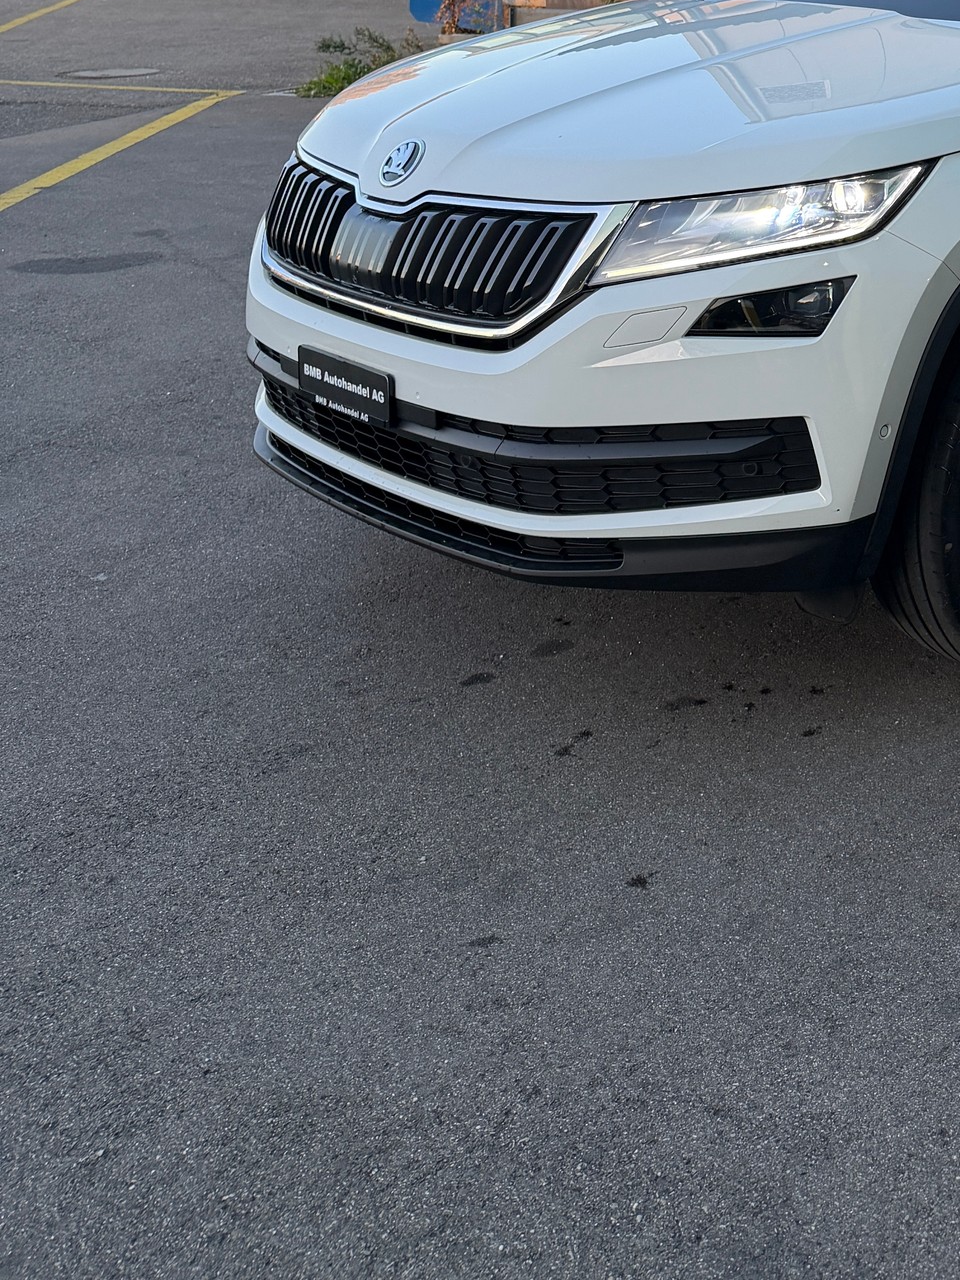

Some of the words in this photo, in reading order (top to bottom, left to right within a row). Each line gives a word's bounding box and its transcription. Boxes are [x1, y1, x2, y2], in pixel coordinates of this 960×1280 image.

[303, 363, 322, 380] BMB
[324, 371, 370, 398] Autohandel
[371, 388, 385, 404] AG
[315, 394, 327, 406] BMB
[328, 400, 359, 418] Autohandel
[360, 412, 369, 422] AG
